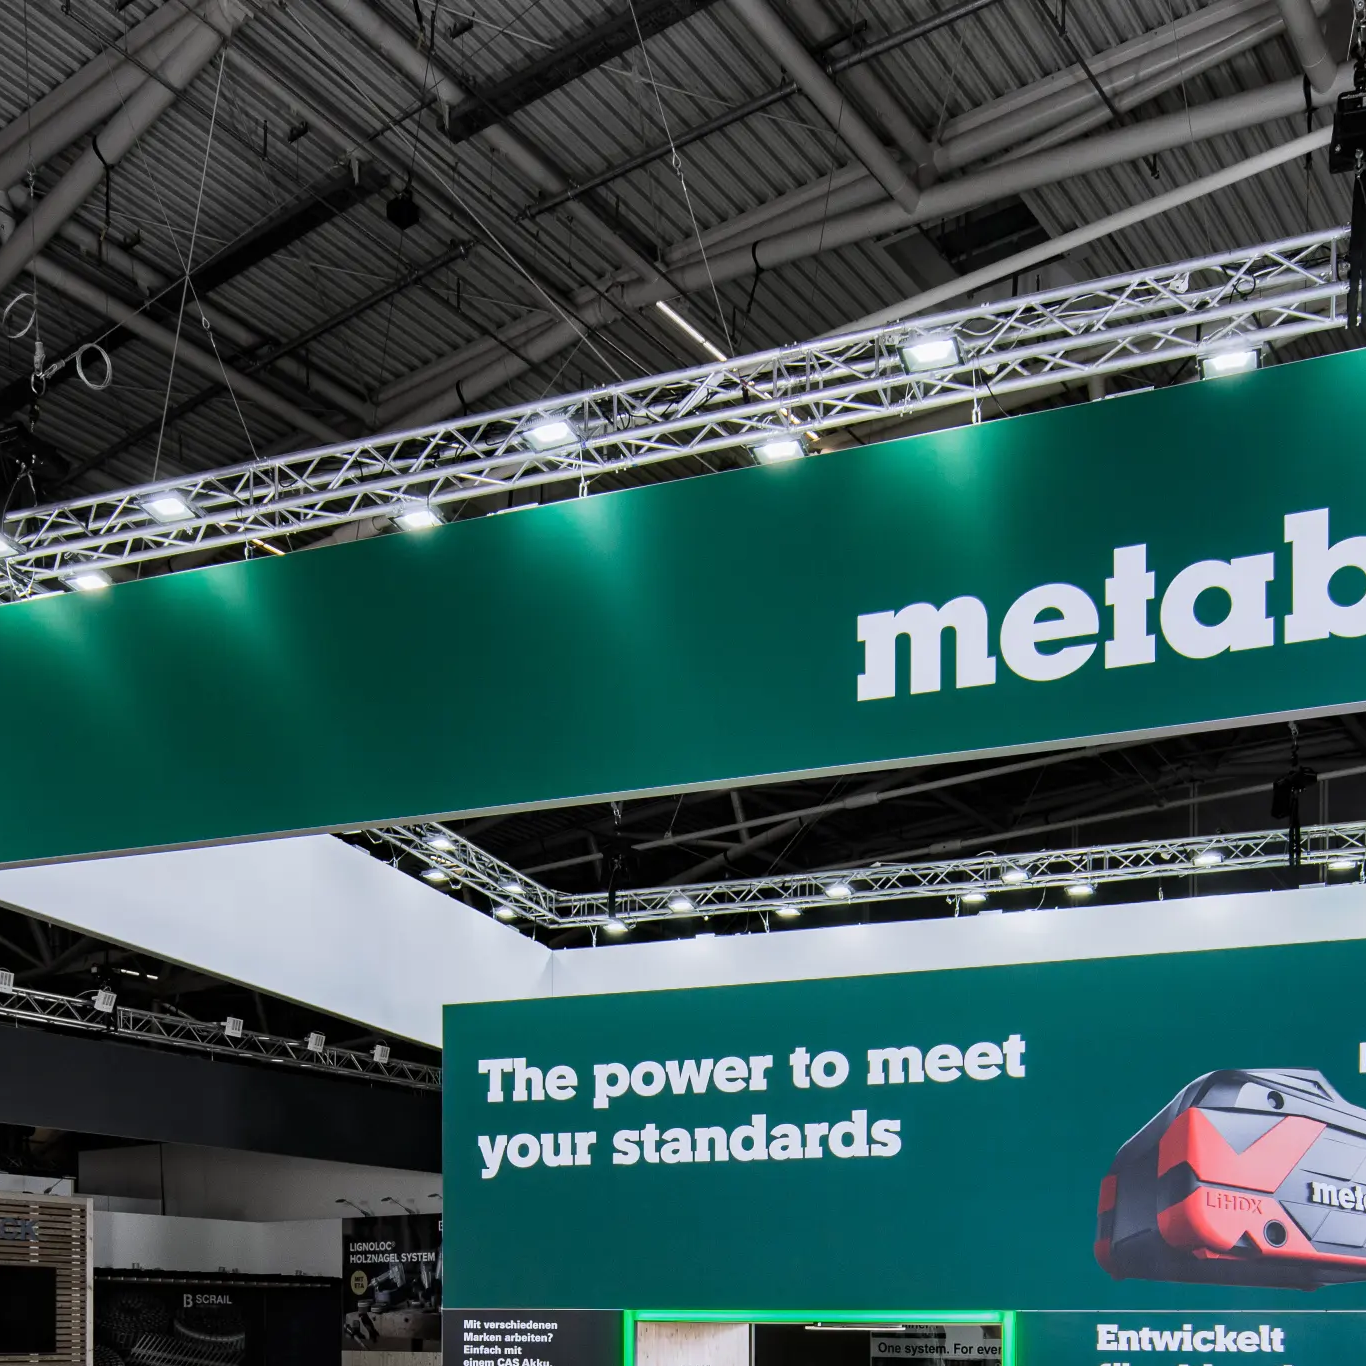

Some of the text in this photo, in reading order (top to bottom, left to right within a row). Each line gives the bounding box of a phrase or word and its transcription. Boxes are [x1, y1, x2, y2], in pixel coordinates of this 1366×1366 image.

[478, 1034, 1026, 1109] The power to meet
[478, 1110, 902, 1179] your standards
[350, 1241, 395, 1252] LIGNOLOC®
[350, 1252, 436, 1264] HOLZNAGEL SYSTEM
[196, 1294, 232, 1306] SCRAIL
[463, 1320, 558, 1330] Mit verschiedenen
[463, 1332, 554, 1342] Marken arbeiten?
[1096, 1324, 1285, 1353] Entwickelt
[463, 1345, 523, 1355] Einfach mit
[878, 1342, 901, 1353] One
[905, 1344, 950, 1356] system.
[954, 1343, 973, 1354] For
[463, 1358, 494, 1366] einem
[497, 1358, 520, 1366] CAS
